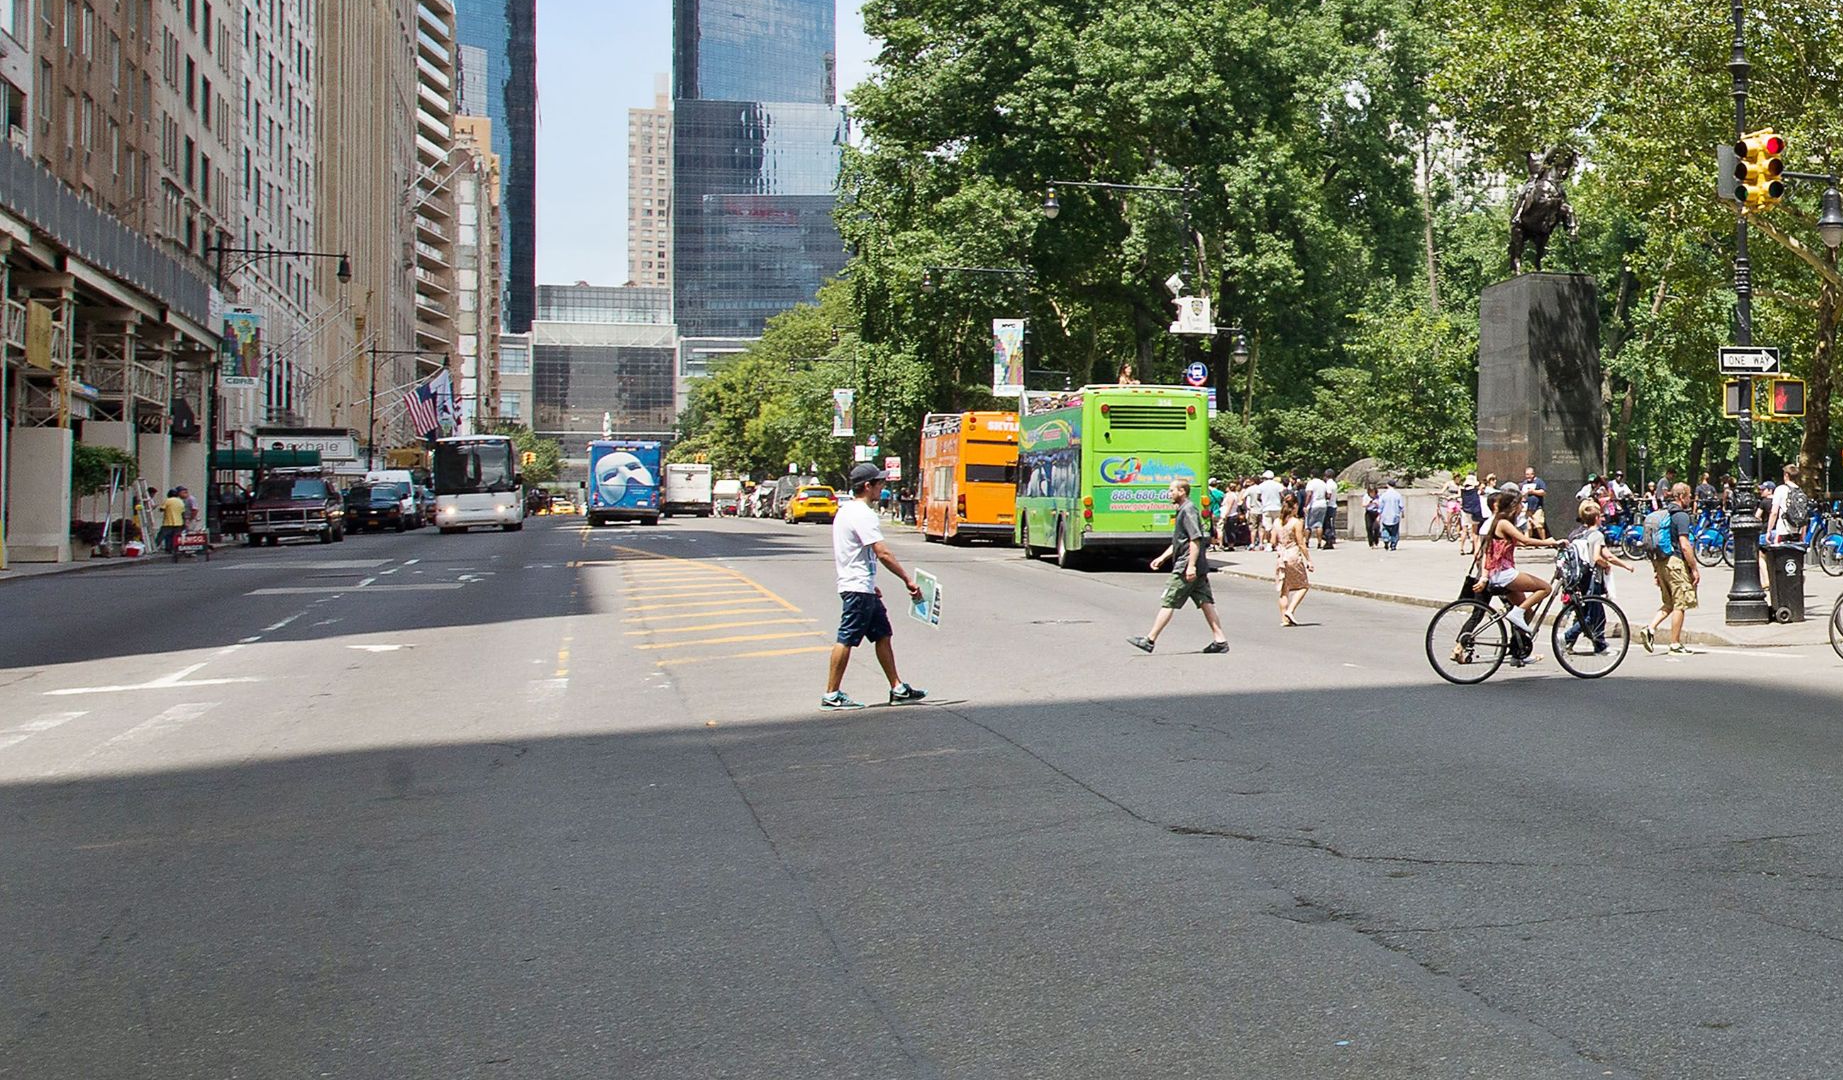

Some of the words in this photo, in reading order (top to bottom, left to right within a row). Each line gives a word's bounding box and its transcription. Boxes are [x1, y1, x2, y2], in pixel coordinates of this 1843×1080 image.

[1728, 355, 1745, 366] ONE
[1752, 355, 1770, 366] WAY
[286, 441, 339, 451] exhale
